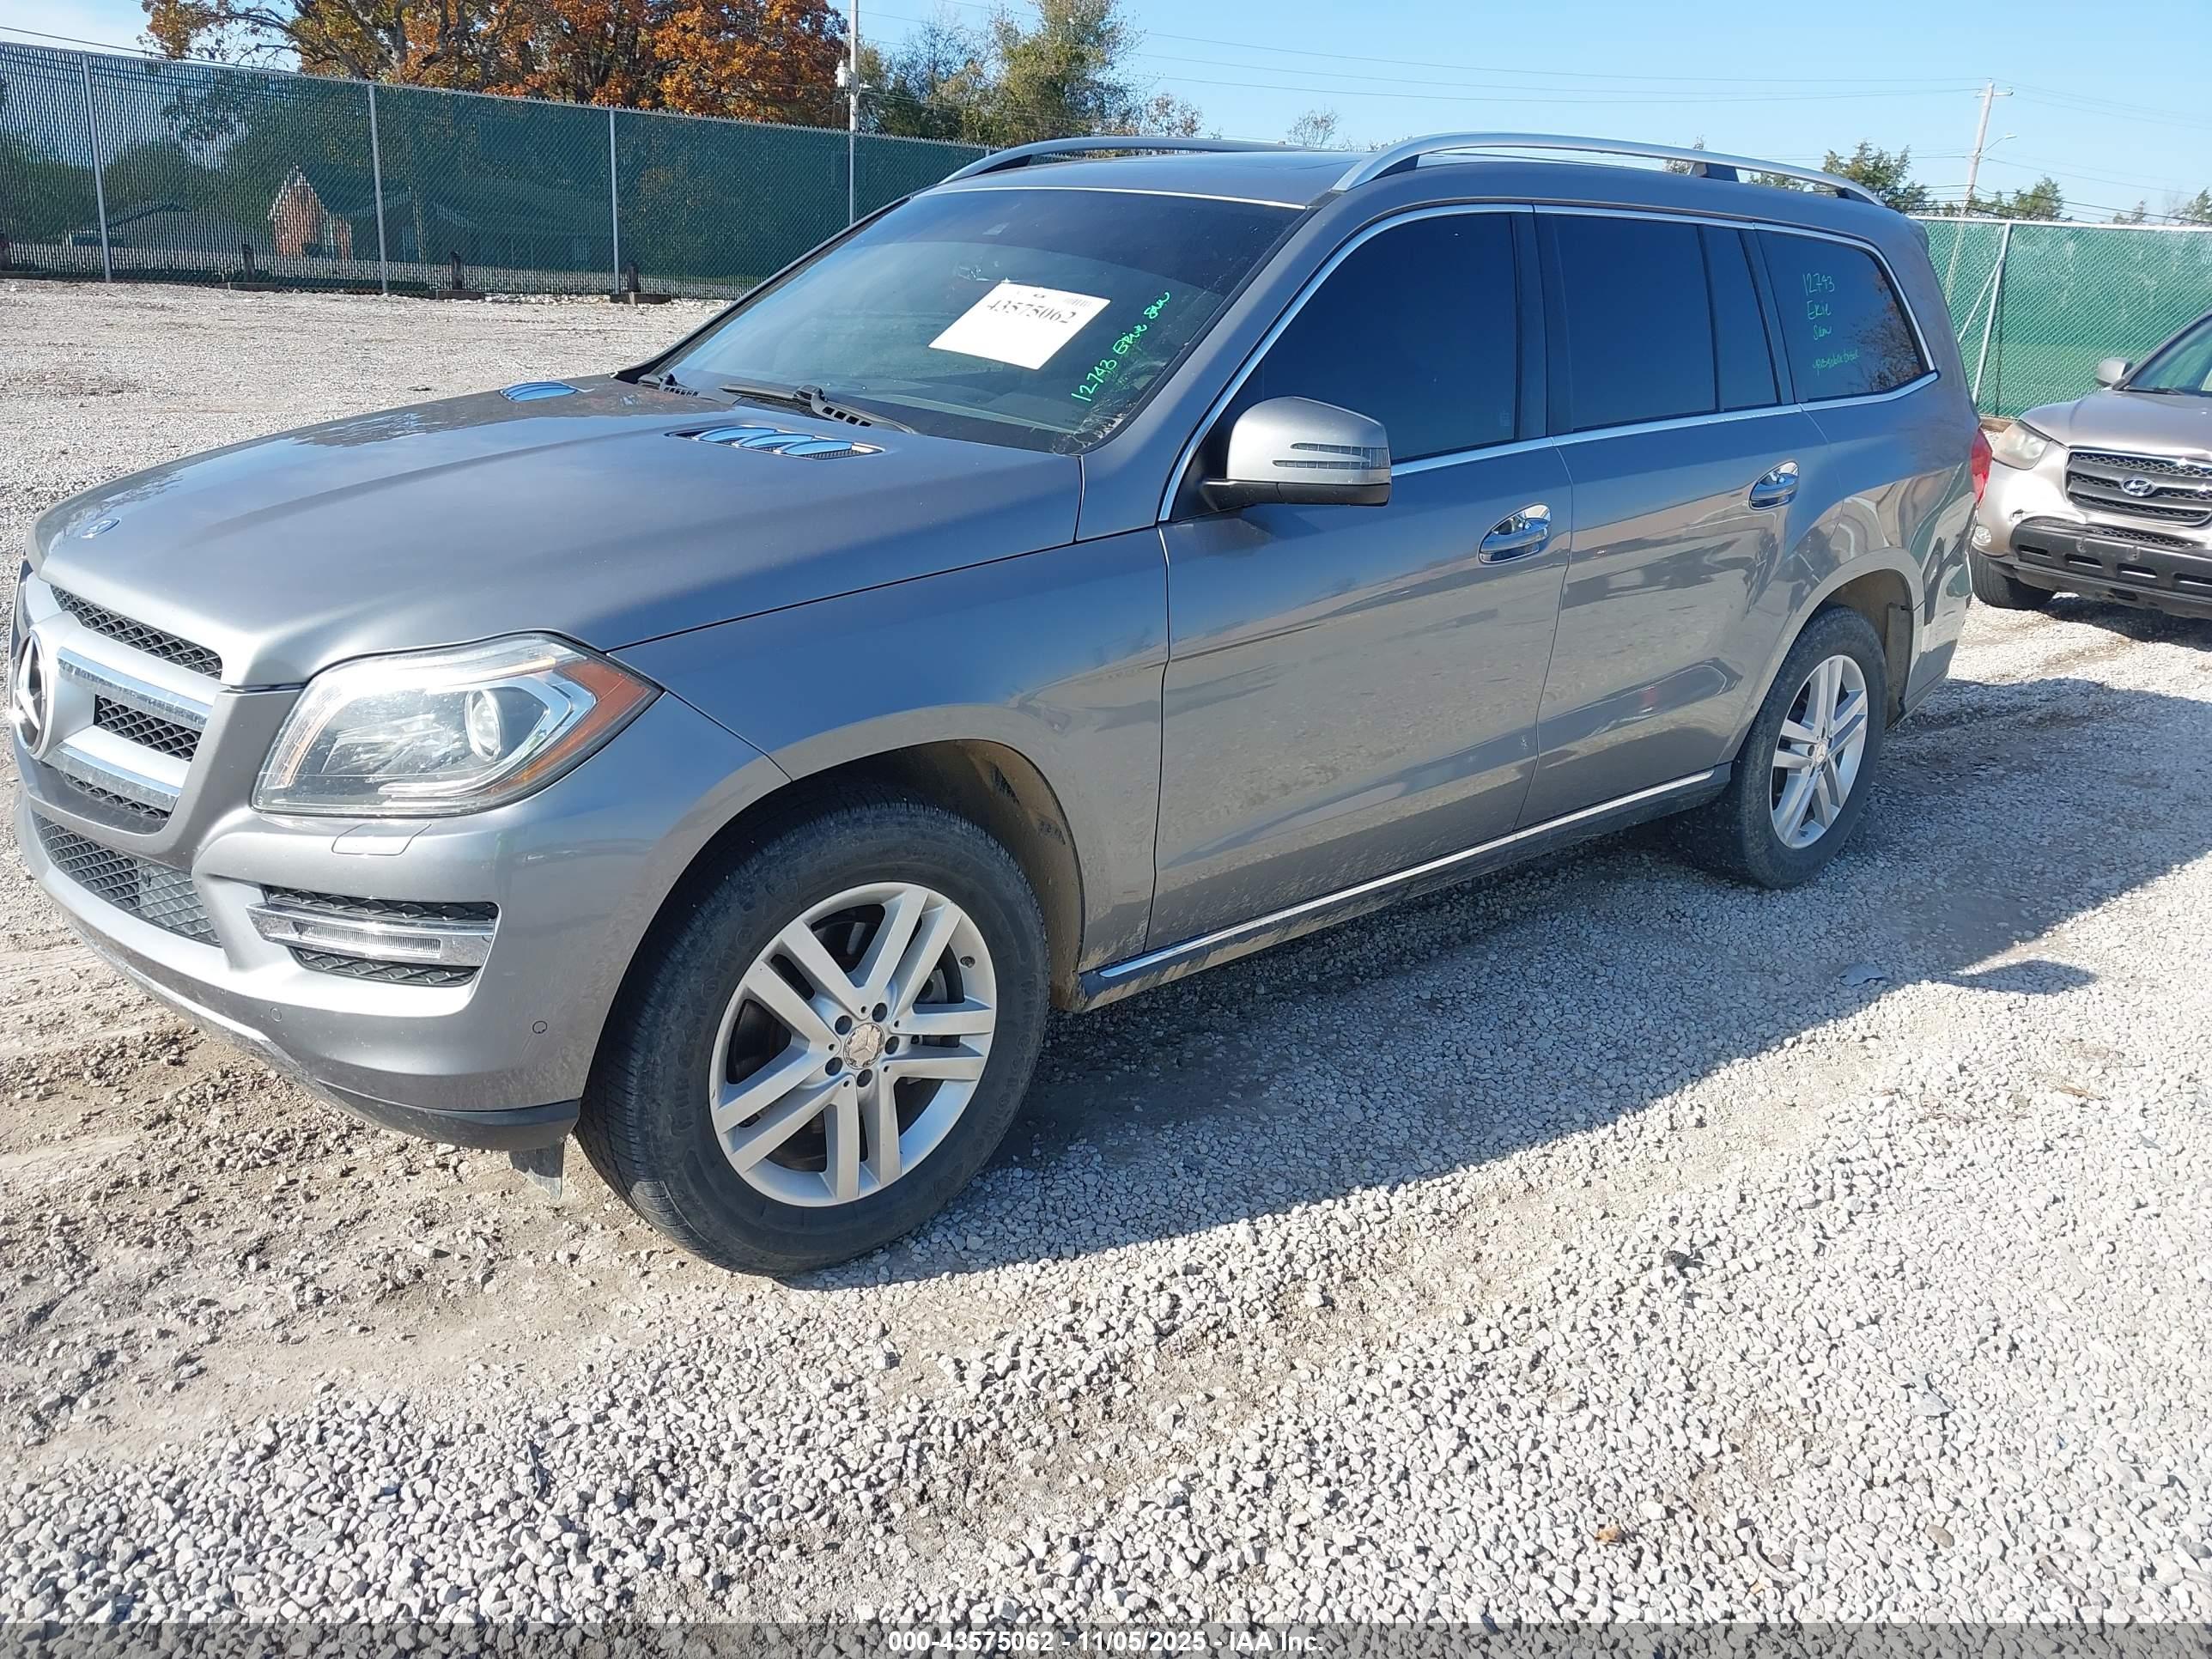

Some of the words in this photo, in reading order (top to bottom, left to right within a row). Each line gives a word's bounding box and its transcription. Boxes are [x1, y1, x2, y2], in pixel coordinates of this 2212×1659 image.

[1802, 272, 1835, 296] 12743
[987, 299, 1077, 324] 43575062
[1071, 358, 1117, 403] 12743
